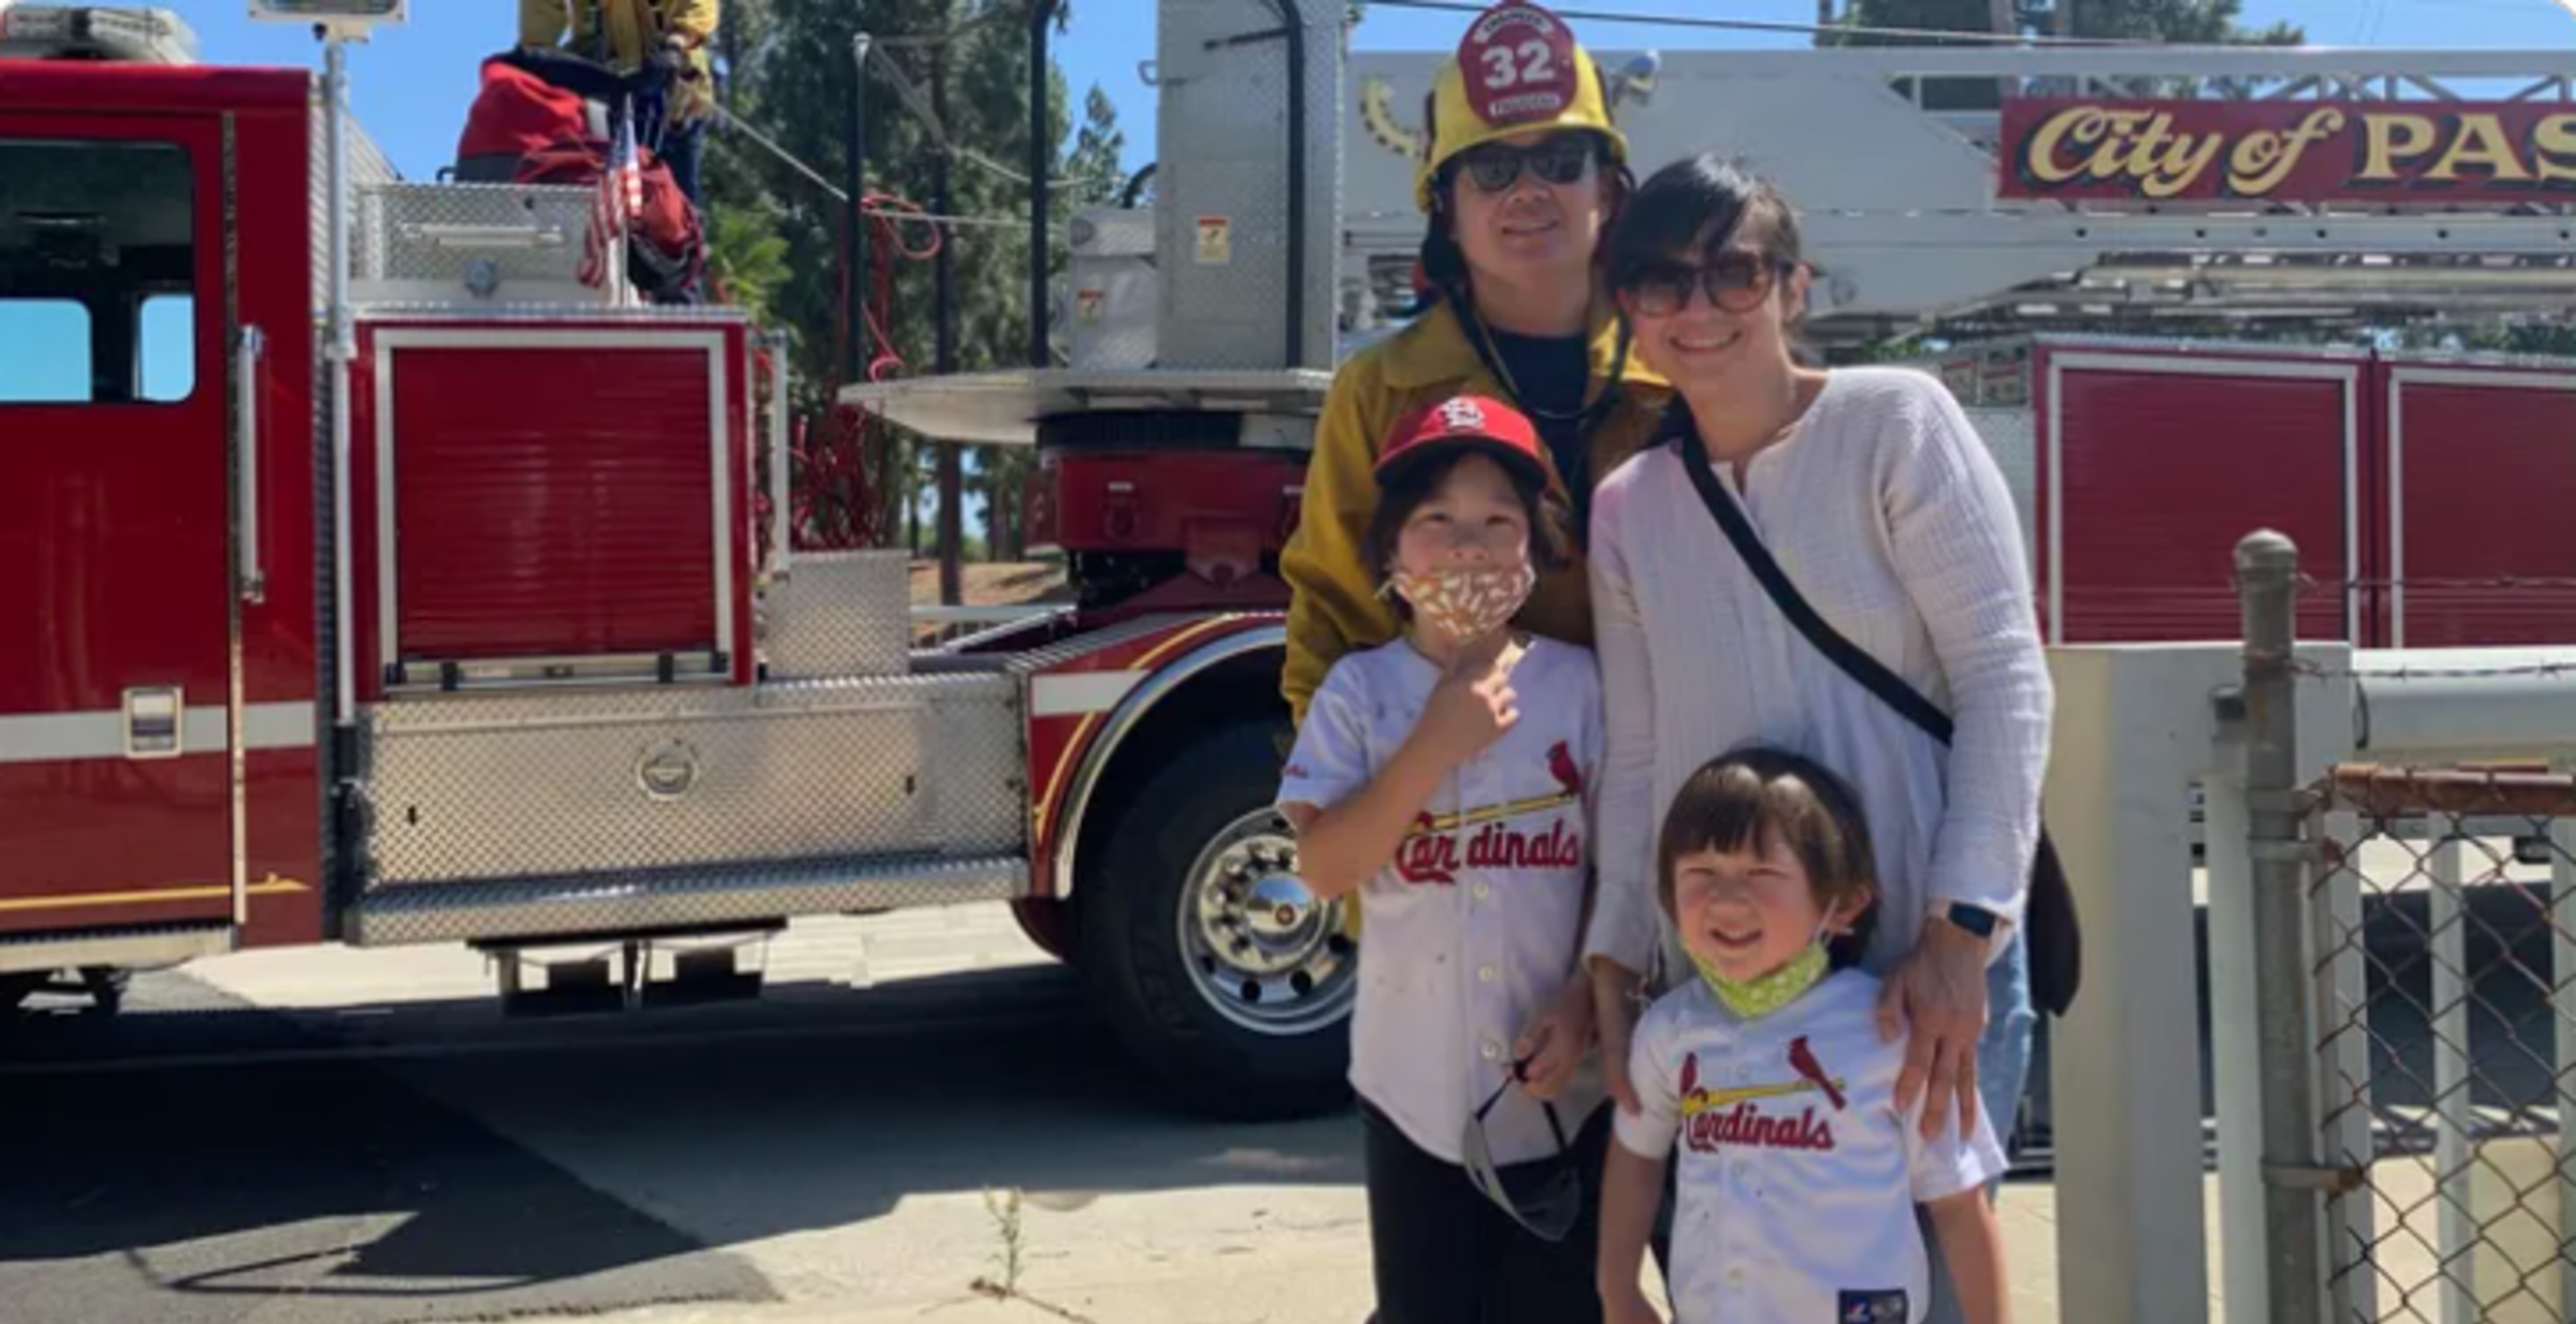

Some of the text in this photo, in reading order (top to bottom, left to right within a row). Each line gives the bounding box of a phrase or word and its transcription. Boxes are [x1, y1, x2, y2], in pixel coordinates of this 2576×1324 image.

[1480, 39, 1555, 89] 32
[2028, 104, 2576, 196] City of PAS
[1686, 1101, 1835, 1155] Cardinals
